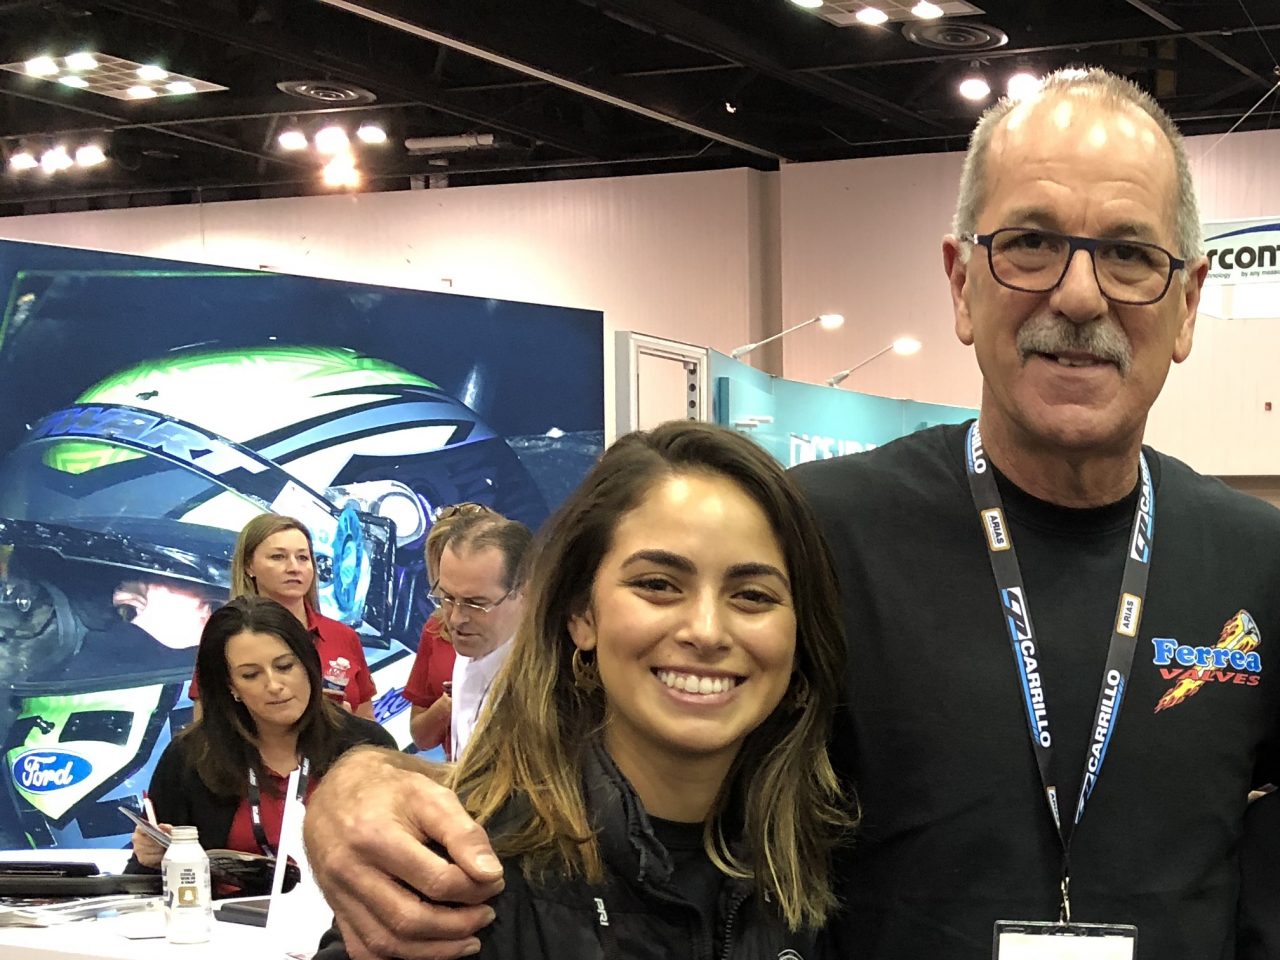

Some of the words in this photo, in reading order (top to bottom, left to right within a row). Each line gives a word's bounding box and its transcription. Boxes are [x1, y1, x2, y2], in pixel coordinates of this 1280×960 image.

[990, 515, 1005, 545] ARIAS
[1122, 600, 1135, 629] ARIAS
[1151, 637, 1262, 673] Ferrea
[1159, 668, 1261, 686] VALVES
[1020, 640, 1051, 748] CARRILLO
[1087, 669, 1121, 773] CARRILLO
[22, 756, 74, 787] Ford
[594, 897, 609, 926] PRI
